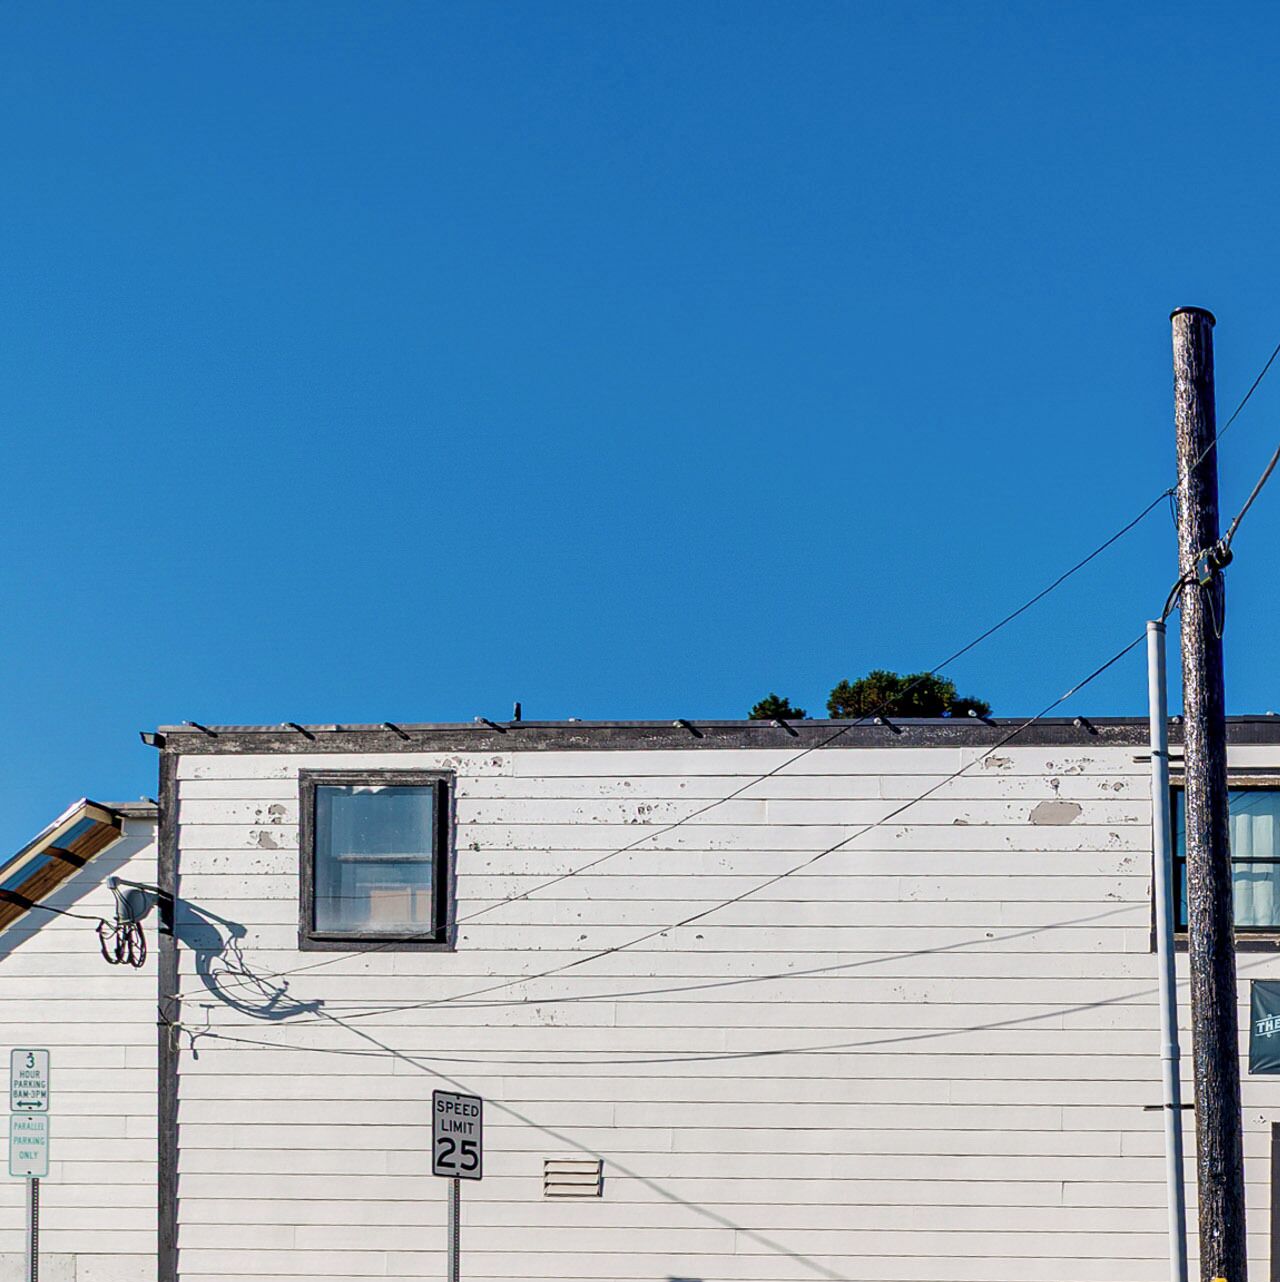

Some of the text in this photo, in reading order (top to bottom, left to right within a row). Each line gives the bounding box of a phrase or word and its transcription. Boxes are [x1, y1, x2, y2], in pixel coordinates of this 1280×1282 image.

[26, 1055, 35, 1069] 3
[19, 1070, 40, 1079] HOUR
[14, 1080, 46, 1088] PARKING
[437, 1100, 480, 1117] SPEED
[14, 1122, 45, 1131] PARALLEL
[441, 1119, 475, 1135] LIMIT
[13, 1136, 45, 1145] PARKING
[18, 1151, 39, 1160] ONLY
[436, 1137, 479, 1171] 25
